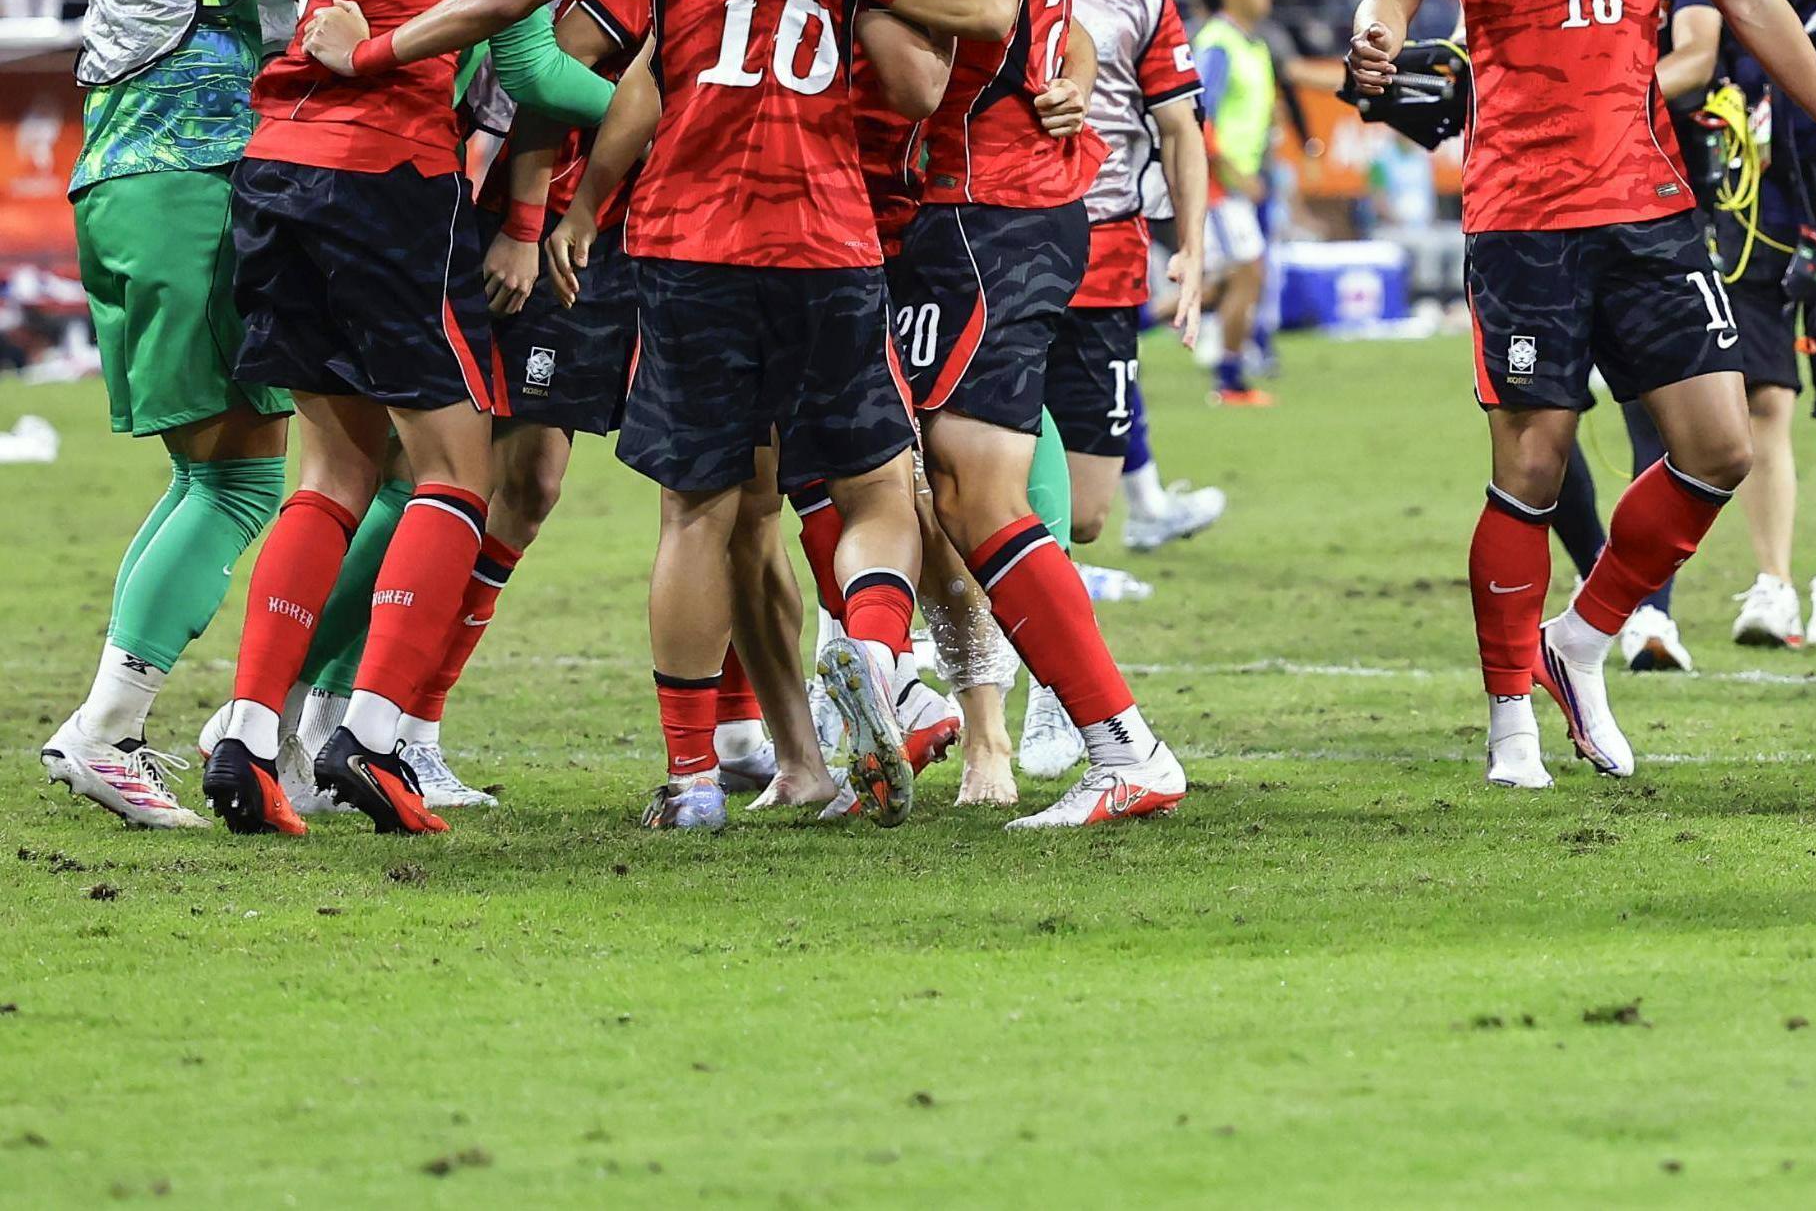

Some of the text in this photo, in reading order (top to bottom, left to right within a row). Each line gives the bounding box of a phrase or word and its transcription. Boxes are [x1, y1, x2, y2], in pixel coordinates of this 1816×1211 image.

[1506, 376, 1534, 385] KOREA
[522, 387, 549, 397] KOREA
[268, 596, 314, 630] KOREA
